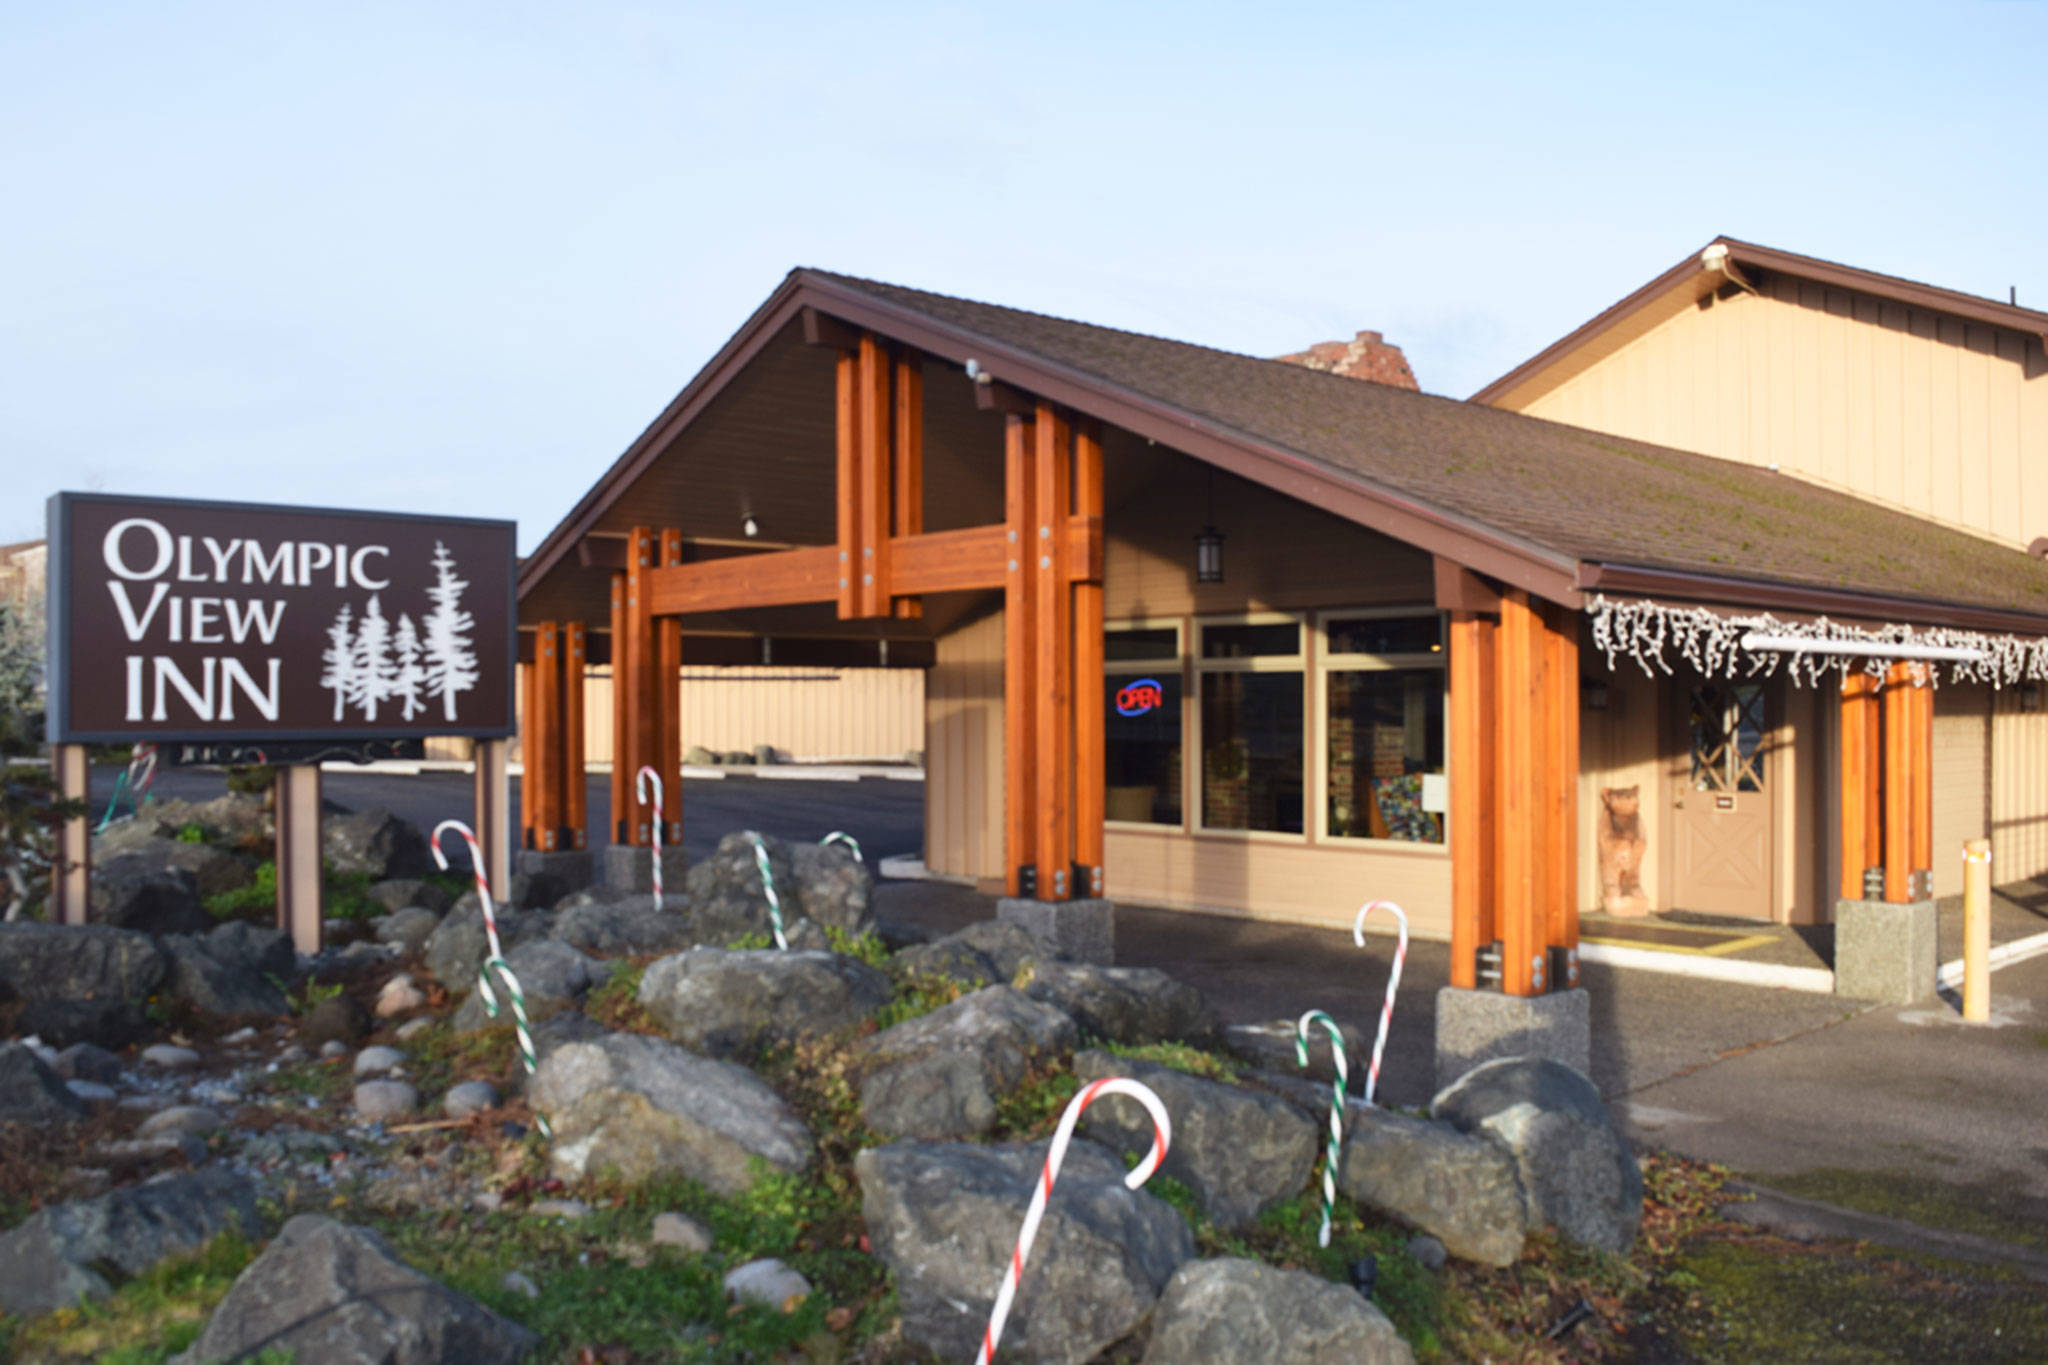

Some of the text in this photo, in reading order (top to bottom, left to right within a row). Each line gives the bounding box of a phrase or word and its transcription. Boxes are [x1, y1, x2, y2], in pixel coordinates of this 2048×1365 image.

[103, 518, 390, 590] OLYMPIC
[107, 580, 286, 644] VIEW
[126, 656, 281, 721] INN
[1115, 687, 1162, 710] OPEN
